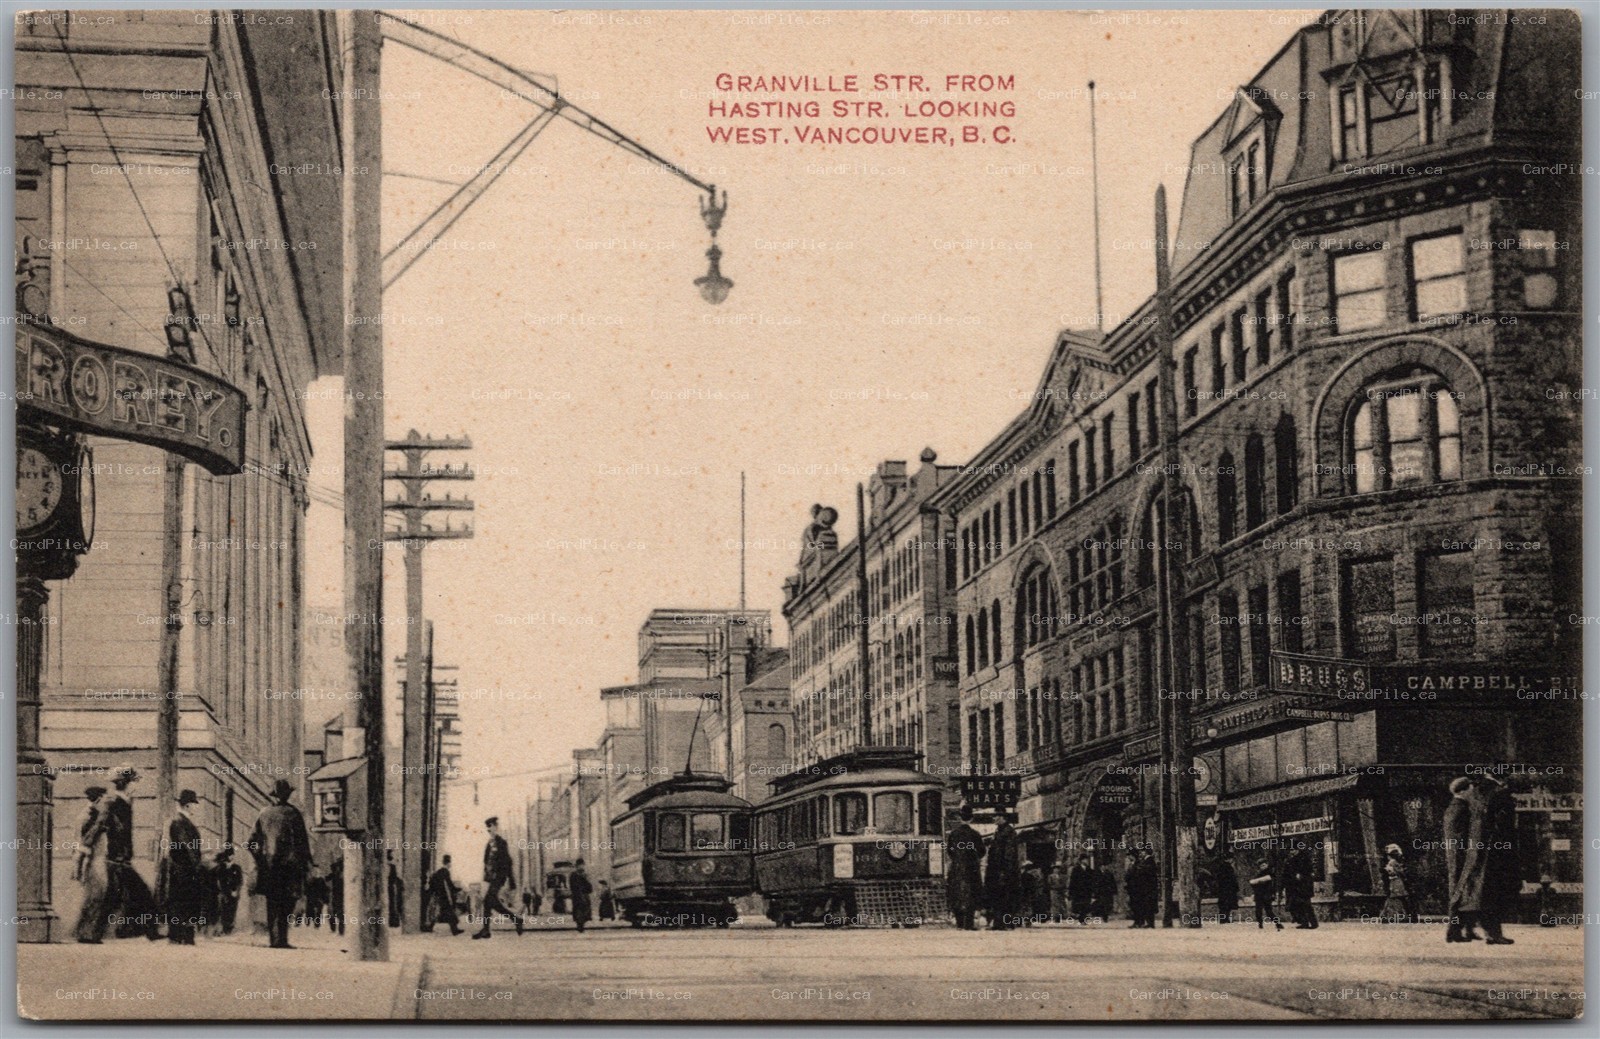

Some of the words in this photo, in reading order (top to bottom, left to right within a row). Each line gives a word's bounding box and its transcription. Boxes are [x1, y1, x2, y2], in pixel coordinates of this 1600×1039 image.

[935, 661, 959, 673] NOR
[1280, 661, 1366, 692] DRUGS
[967, 780, 1016, 790] HEATH
[973, 793, 1010, 803] HATS
[1099, 795, 1131, 804] SEATTLE
